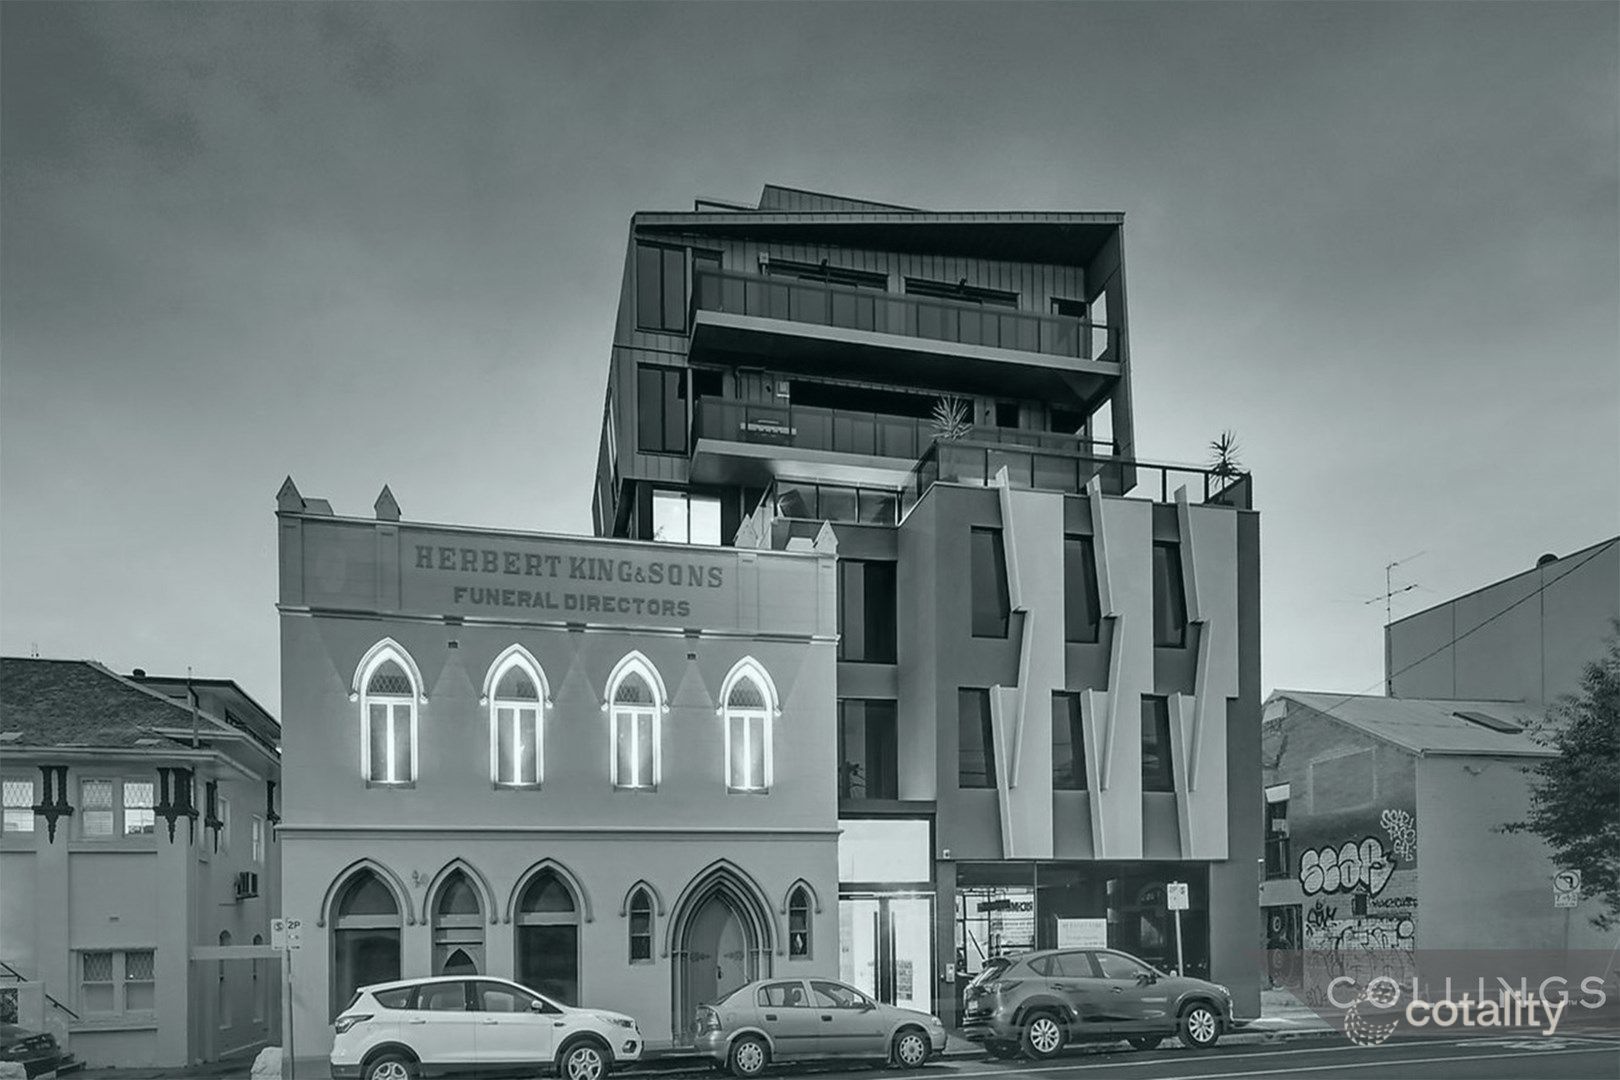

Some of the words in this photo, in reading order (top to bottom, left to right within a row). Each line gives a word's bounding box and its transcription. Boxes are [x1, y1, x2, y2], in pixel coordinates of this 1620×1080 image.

[415, 545, 562, 578] HERBERT
[454, 586, 559, 610] FUNERAL
[564, 593, 691, 617] DIRECTORS
[288, 920, 301, 930] 2P
